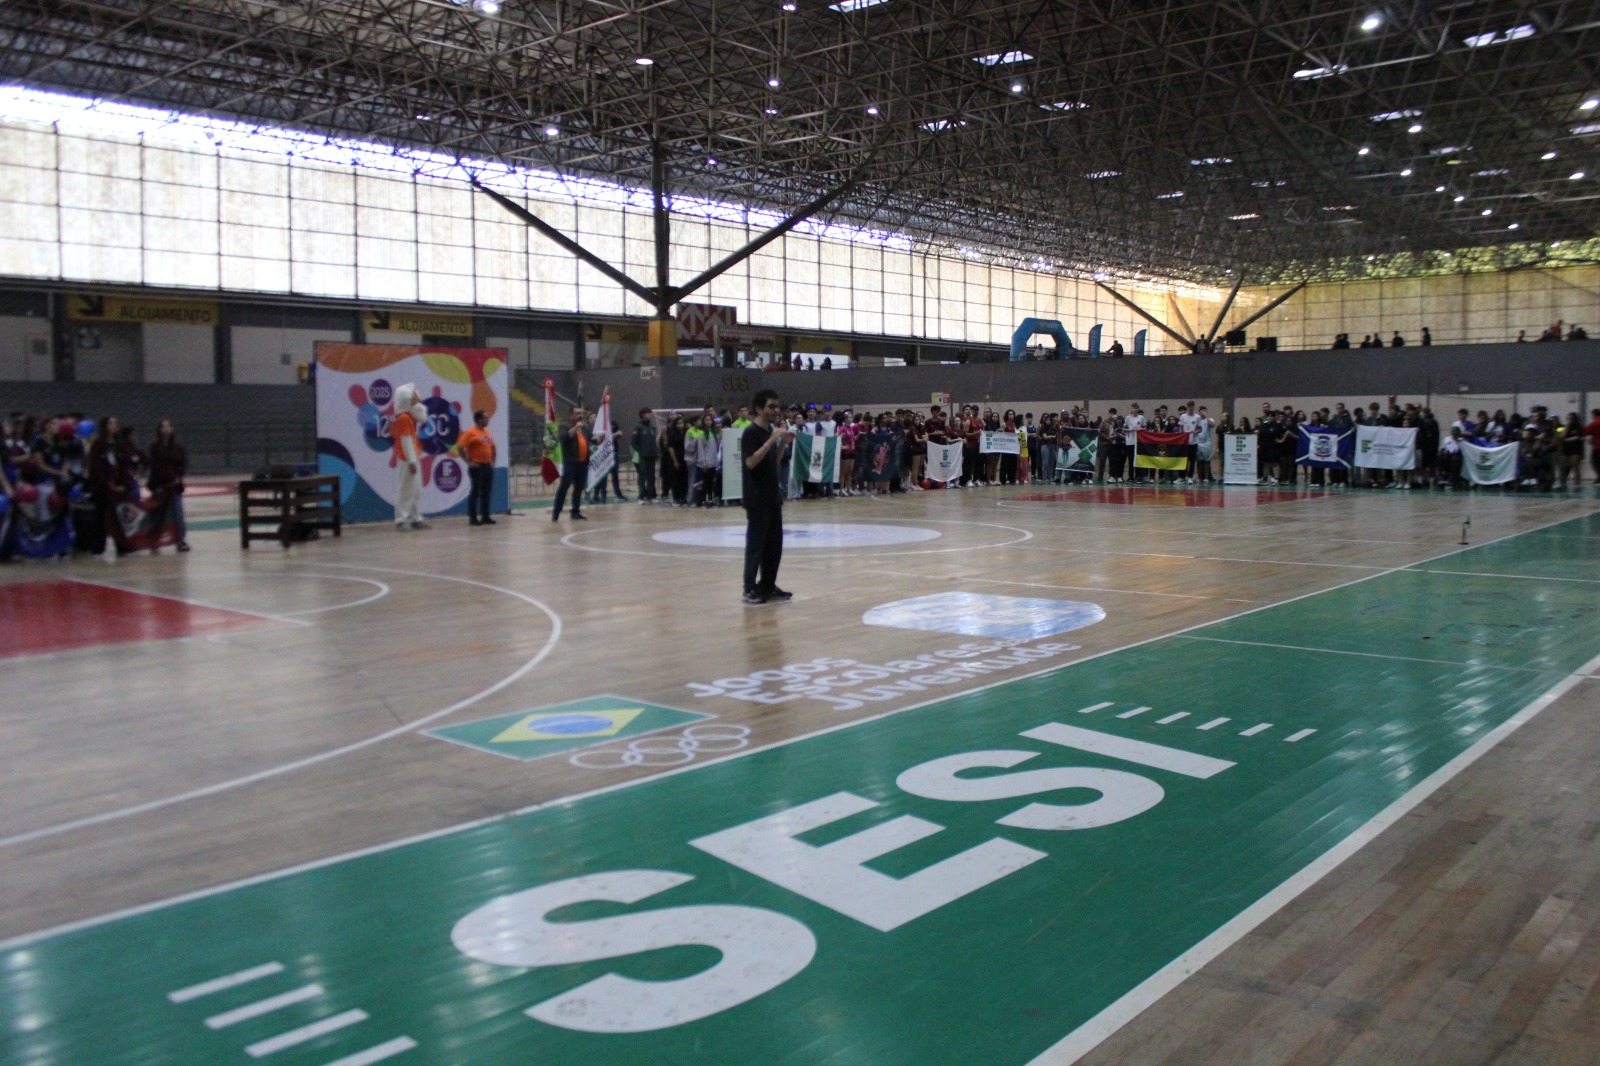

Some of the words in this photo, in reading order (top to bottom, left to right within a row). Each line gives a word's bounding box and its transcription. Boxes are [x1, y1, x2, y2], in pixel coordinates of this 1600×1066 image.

[118, 306, 211, 322] ALOJAMENTO
[397, 319, 467, 334] ALOJAMENTO
[369, 387, 391, 398] 2025
[685, 656, 858, 698] Jogos
[724, 642, 1002, 705] Escolares
[807, 642, 1082, 712] Juventude
[449, 720, 1238, 1034] SESI
